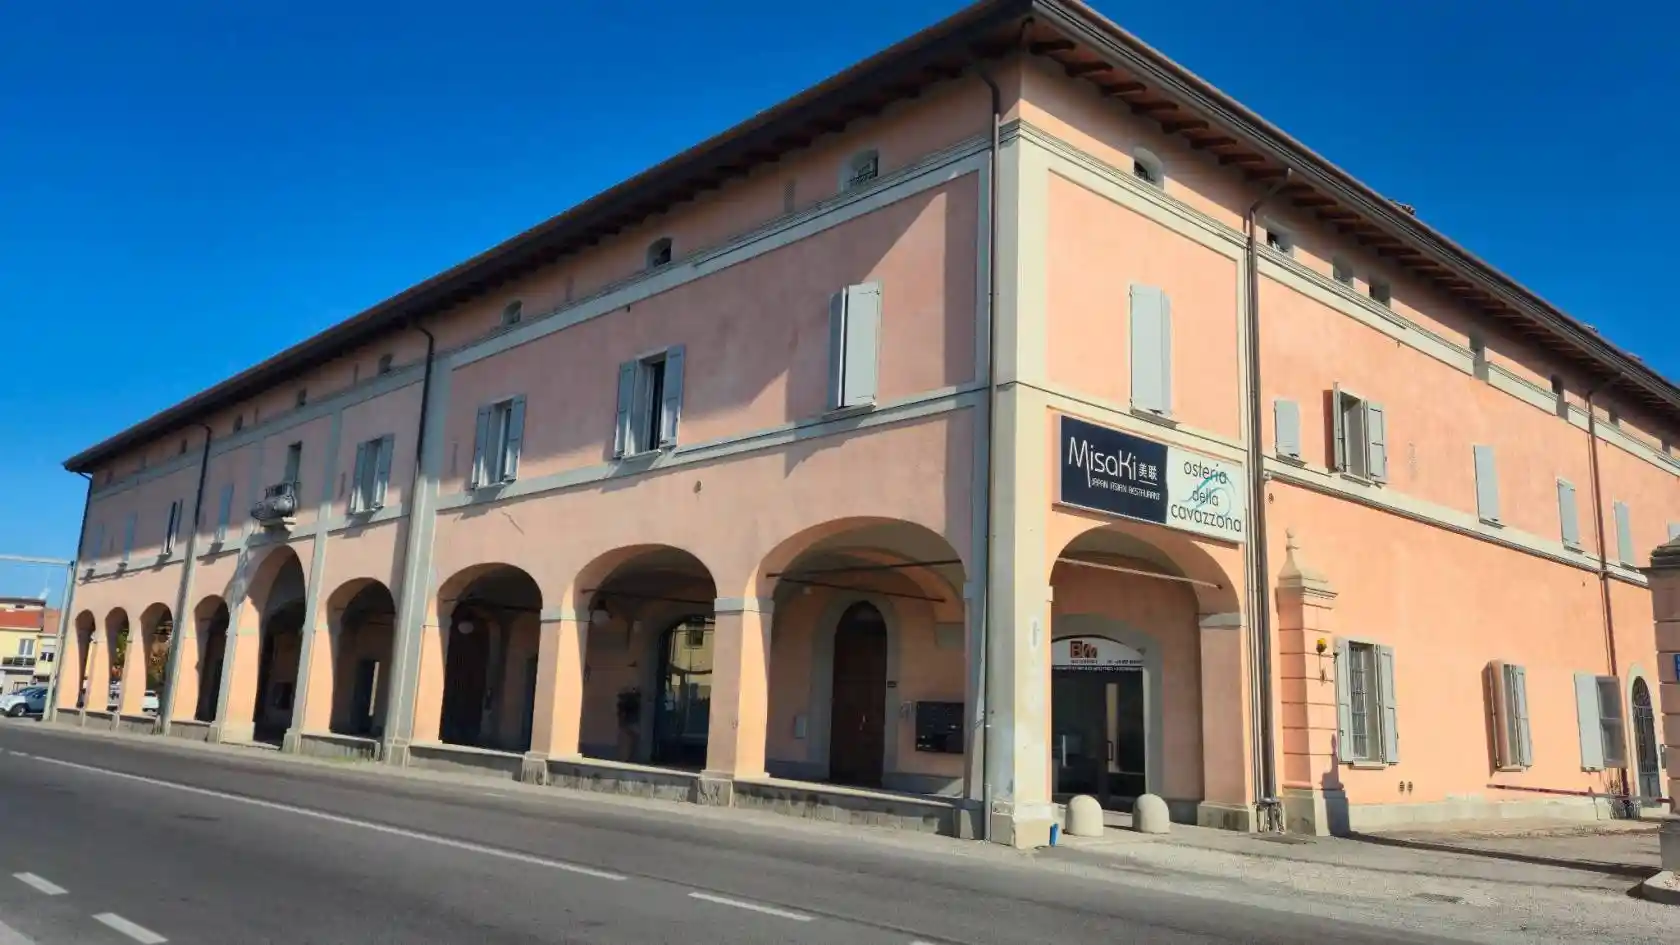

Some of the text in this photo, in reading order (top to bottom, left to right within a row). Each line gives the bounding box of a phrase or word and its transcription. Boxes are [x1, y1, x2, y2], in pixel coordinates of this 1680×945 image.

[1183, 459, 1227, 484] osteria
[1128, 486, 1160, 500] RESTAURANT
[1192, 487, 1219, 507] della
[1171, 502, 1242, 533] cavazzona
